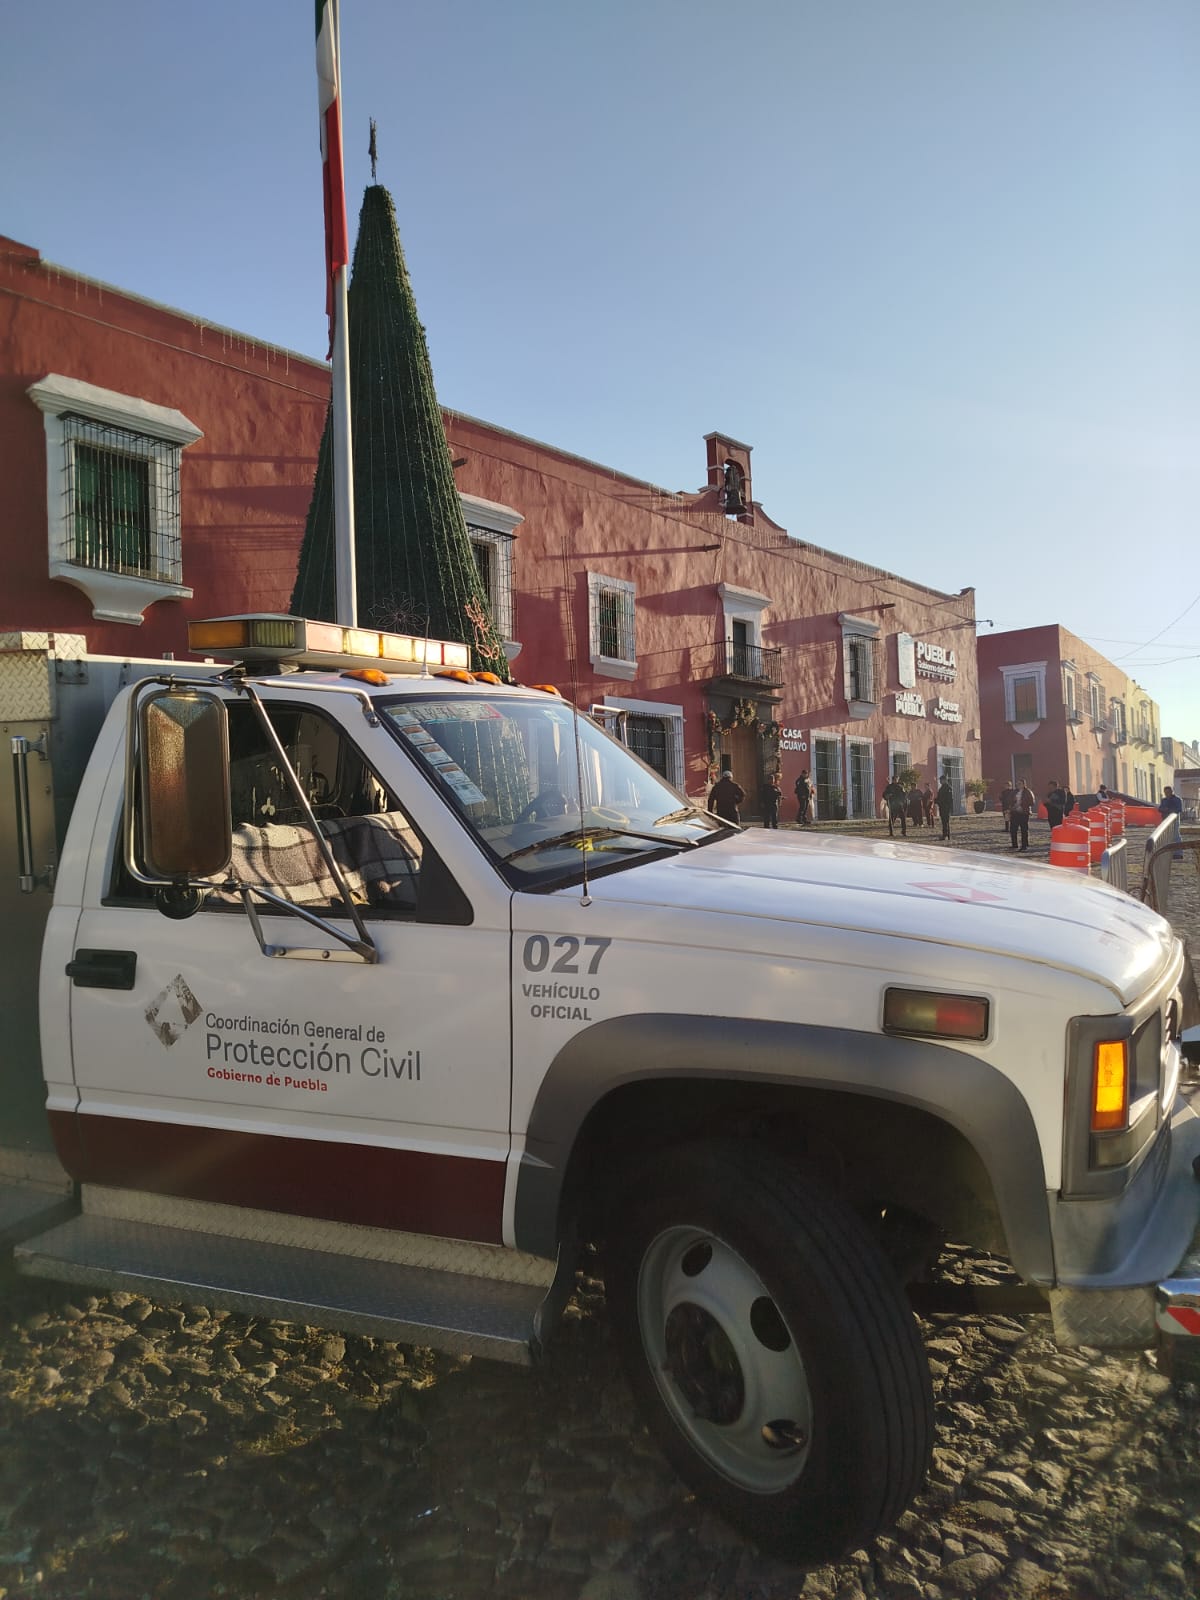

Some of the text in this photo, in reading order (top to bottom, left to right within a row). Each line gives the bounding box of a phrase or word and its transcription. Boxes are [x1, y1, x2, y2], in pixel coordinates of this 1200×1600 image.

[917, 641, 956, 668] PUEBLA
[903, 691, 922, 705] AMOR
[895, 700, 926, 718] PUEBLA
[782, 728, 802, 739] CASA
[779, 739, 807, 752] AGUAYO
[523, 934, 612, 975] 027
[522, 982, 600, 1001] VEHÍCULO
[530, 1004, 592, 1021] OFICIAL
[205, 1012, 385, 1043] Coordinación General de
[206, 1033, 420, 1081] Protección Civil
[207, 1066, 328, 1092] Gobierno de Puebla
